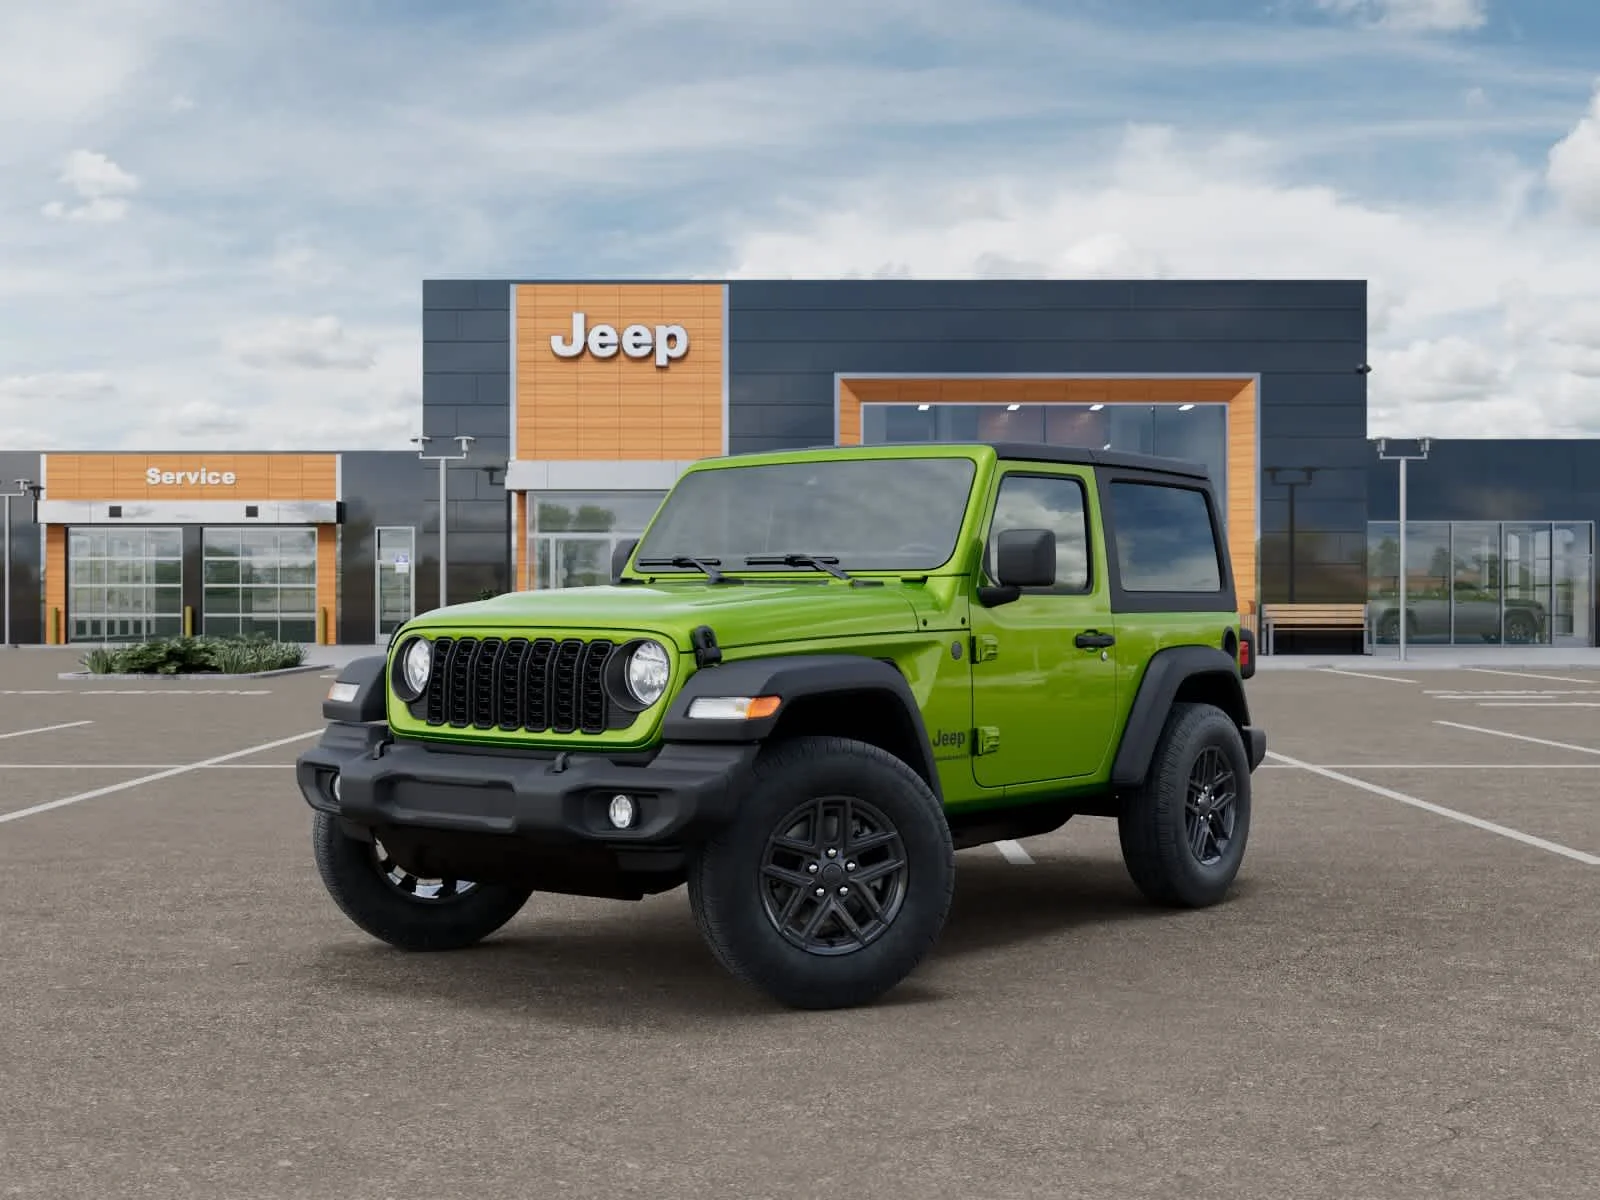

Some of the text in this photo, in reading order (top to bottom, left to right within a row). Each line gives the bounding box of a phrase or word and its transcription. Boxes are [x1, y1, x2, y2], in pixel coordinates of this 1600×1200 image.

[550, 311, 689, 368] Jeep
[145, 466, 236, 486] Service
[932, 729, 965, 748] Jeep
